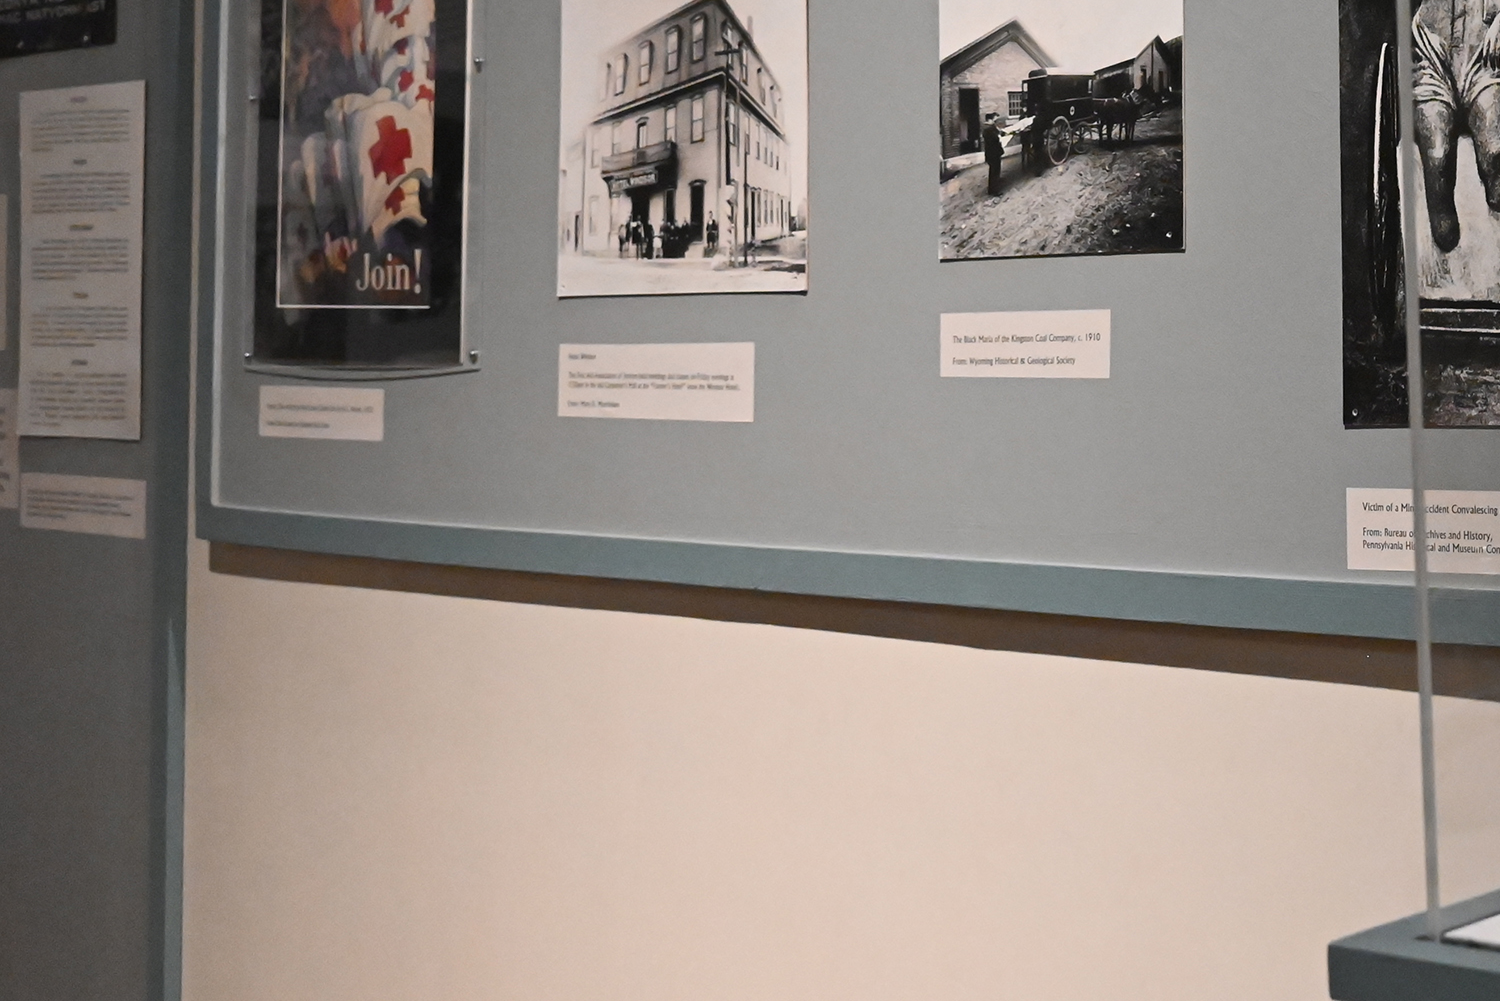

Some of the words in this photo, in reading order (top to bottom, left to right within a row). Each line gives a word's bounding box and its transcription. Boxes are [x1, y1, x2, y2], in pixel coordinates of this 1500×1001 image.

[355, 248, 422, 294] Join!
[1048, 333, 1077, 343] Company,
[1085, 332, 1101, 342] 1910
[1361, 501, 1384, 512] Victim
[1385, 502, 1393, 512] of
[1394, 504, 1399, 512] a
[1400, 502, 1414, 512] Min
[1425, 504, 1450, 514] ccident
[1451, 503, 1498, 517] Convalescing
[1362, 526, 1382, 537] From:
[1383, 527, 1407, 538] Bureau
[1447, 530, 1461, 540] and
[1463, 530, 1493, 542] History,
[1362, 539, 1403, 551] Pennsylvania
[1437, 543, 1450, 553] and
